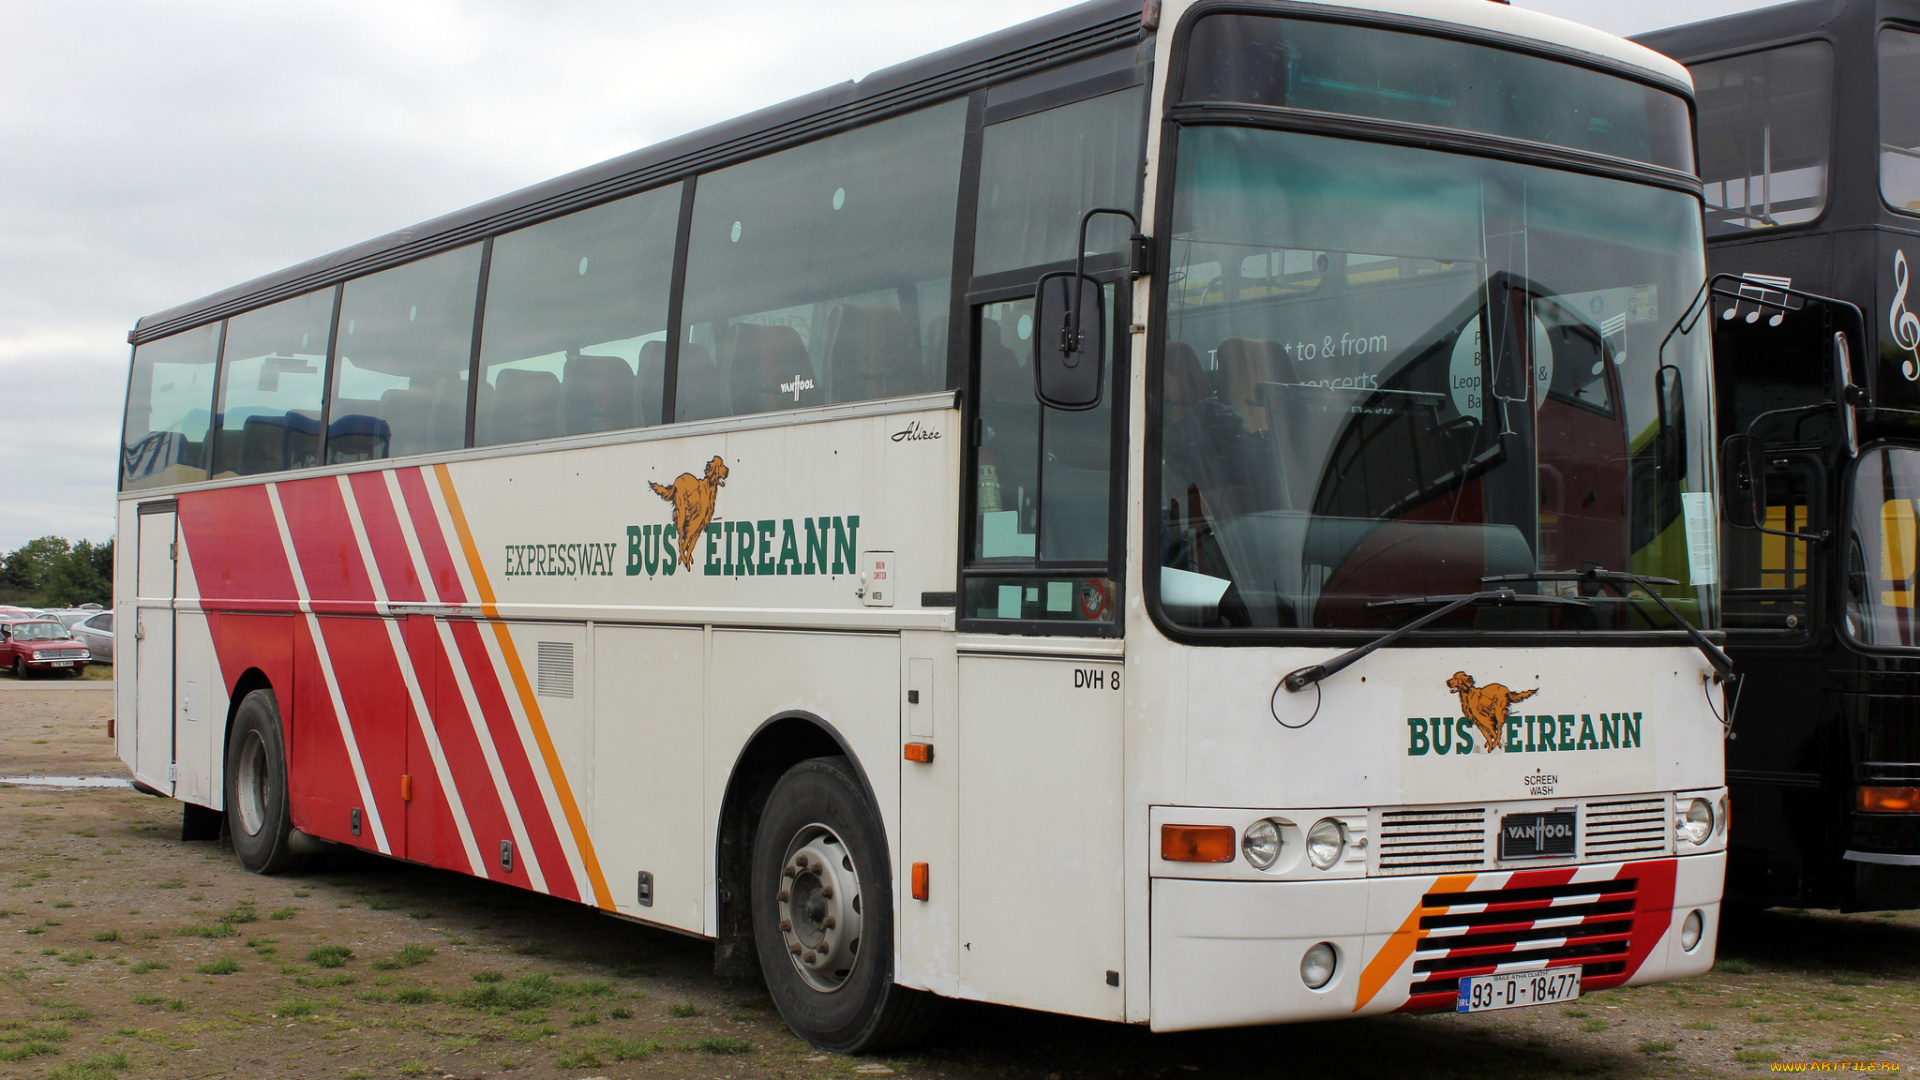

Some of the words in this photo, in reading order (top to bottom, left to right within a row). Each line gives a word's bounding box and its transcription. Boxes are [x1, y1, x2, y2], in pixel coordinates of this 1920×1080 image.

[1296, 341, 1316, 361] to
[1321, 335, 1335, 358] &
[1340, 332, 1387, 357] from
[1538, 366, 1548, 381] &
[505, 542, 617, 577] EXPRESSWAY
[626, 522, 678, 577] BUS
[1074, 669, 1104, 690] DVH
[1110, 671, 1120, 690] 8
[1407, 716, 1474, 756] BUS
[1524, 774, 1558, 786] SCREEN
[1530, 786, 1554, 796] WASH
[1459, 998, 1470, 1007] IRL
